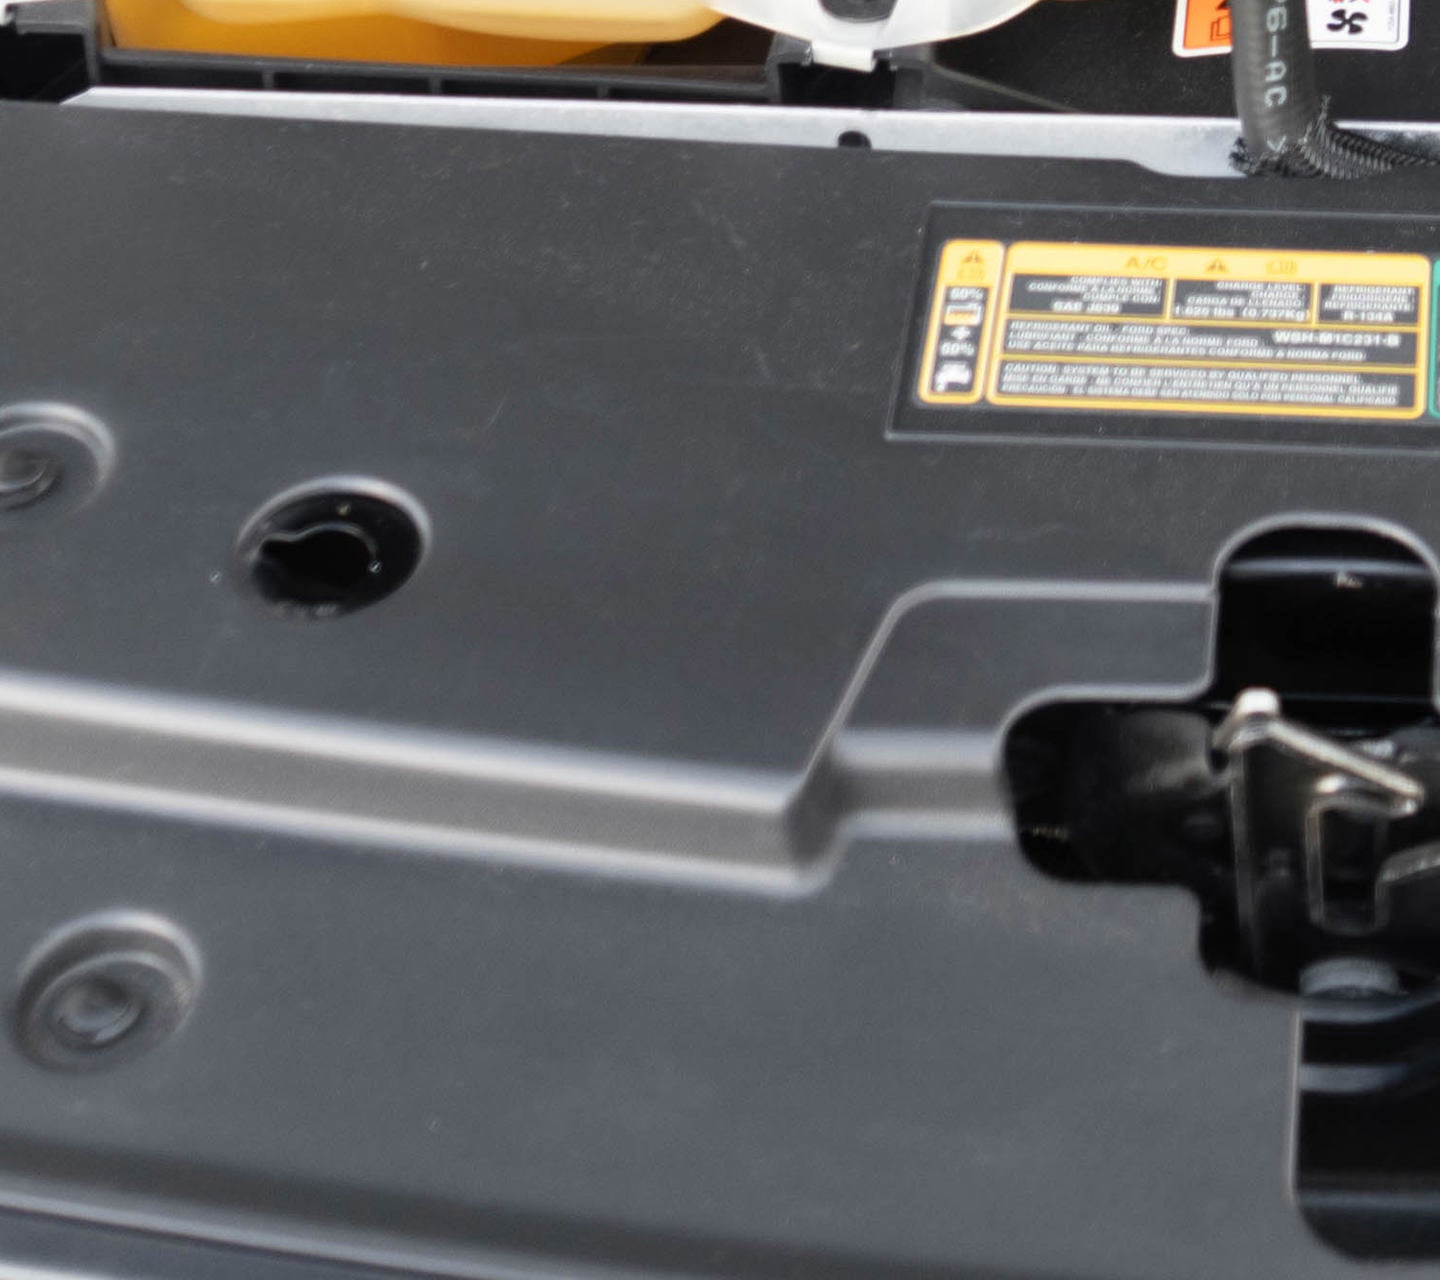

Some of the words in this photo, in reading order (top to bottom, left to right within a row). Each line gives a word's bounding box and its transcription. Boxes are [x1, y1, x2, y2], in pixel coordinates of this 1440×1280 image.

[1125, 256, 1168, 271] A/C
[1216, 281, 1264, 290] CHARGE
[1052, 300, 1083, 312] SAE
[1228, 297, 1246, 305] DE
[1342, 309, 1392, 321] R-134A
[1112, 365, 1128, 376] TO
[1129, 366, 1146, 376] BE
[1208, 368, 1226, 379] BY
